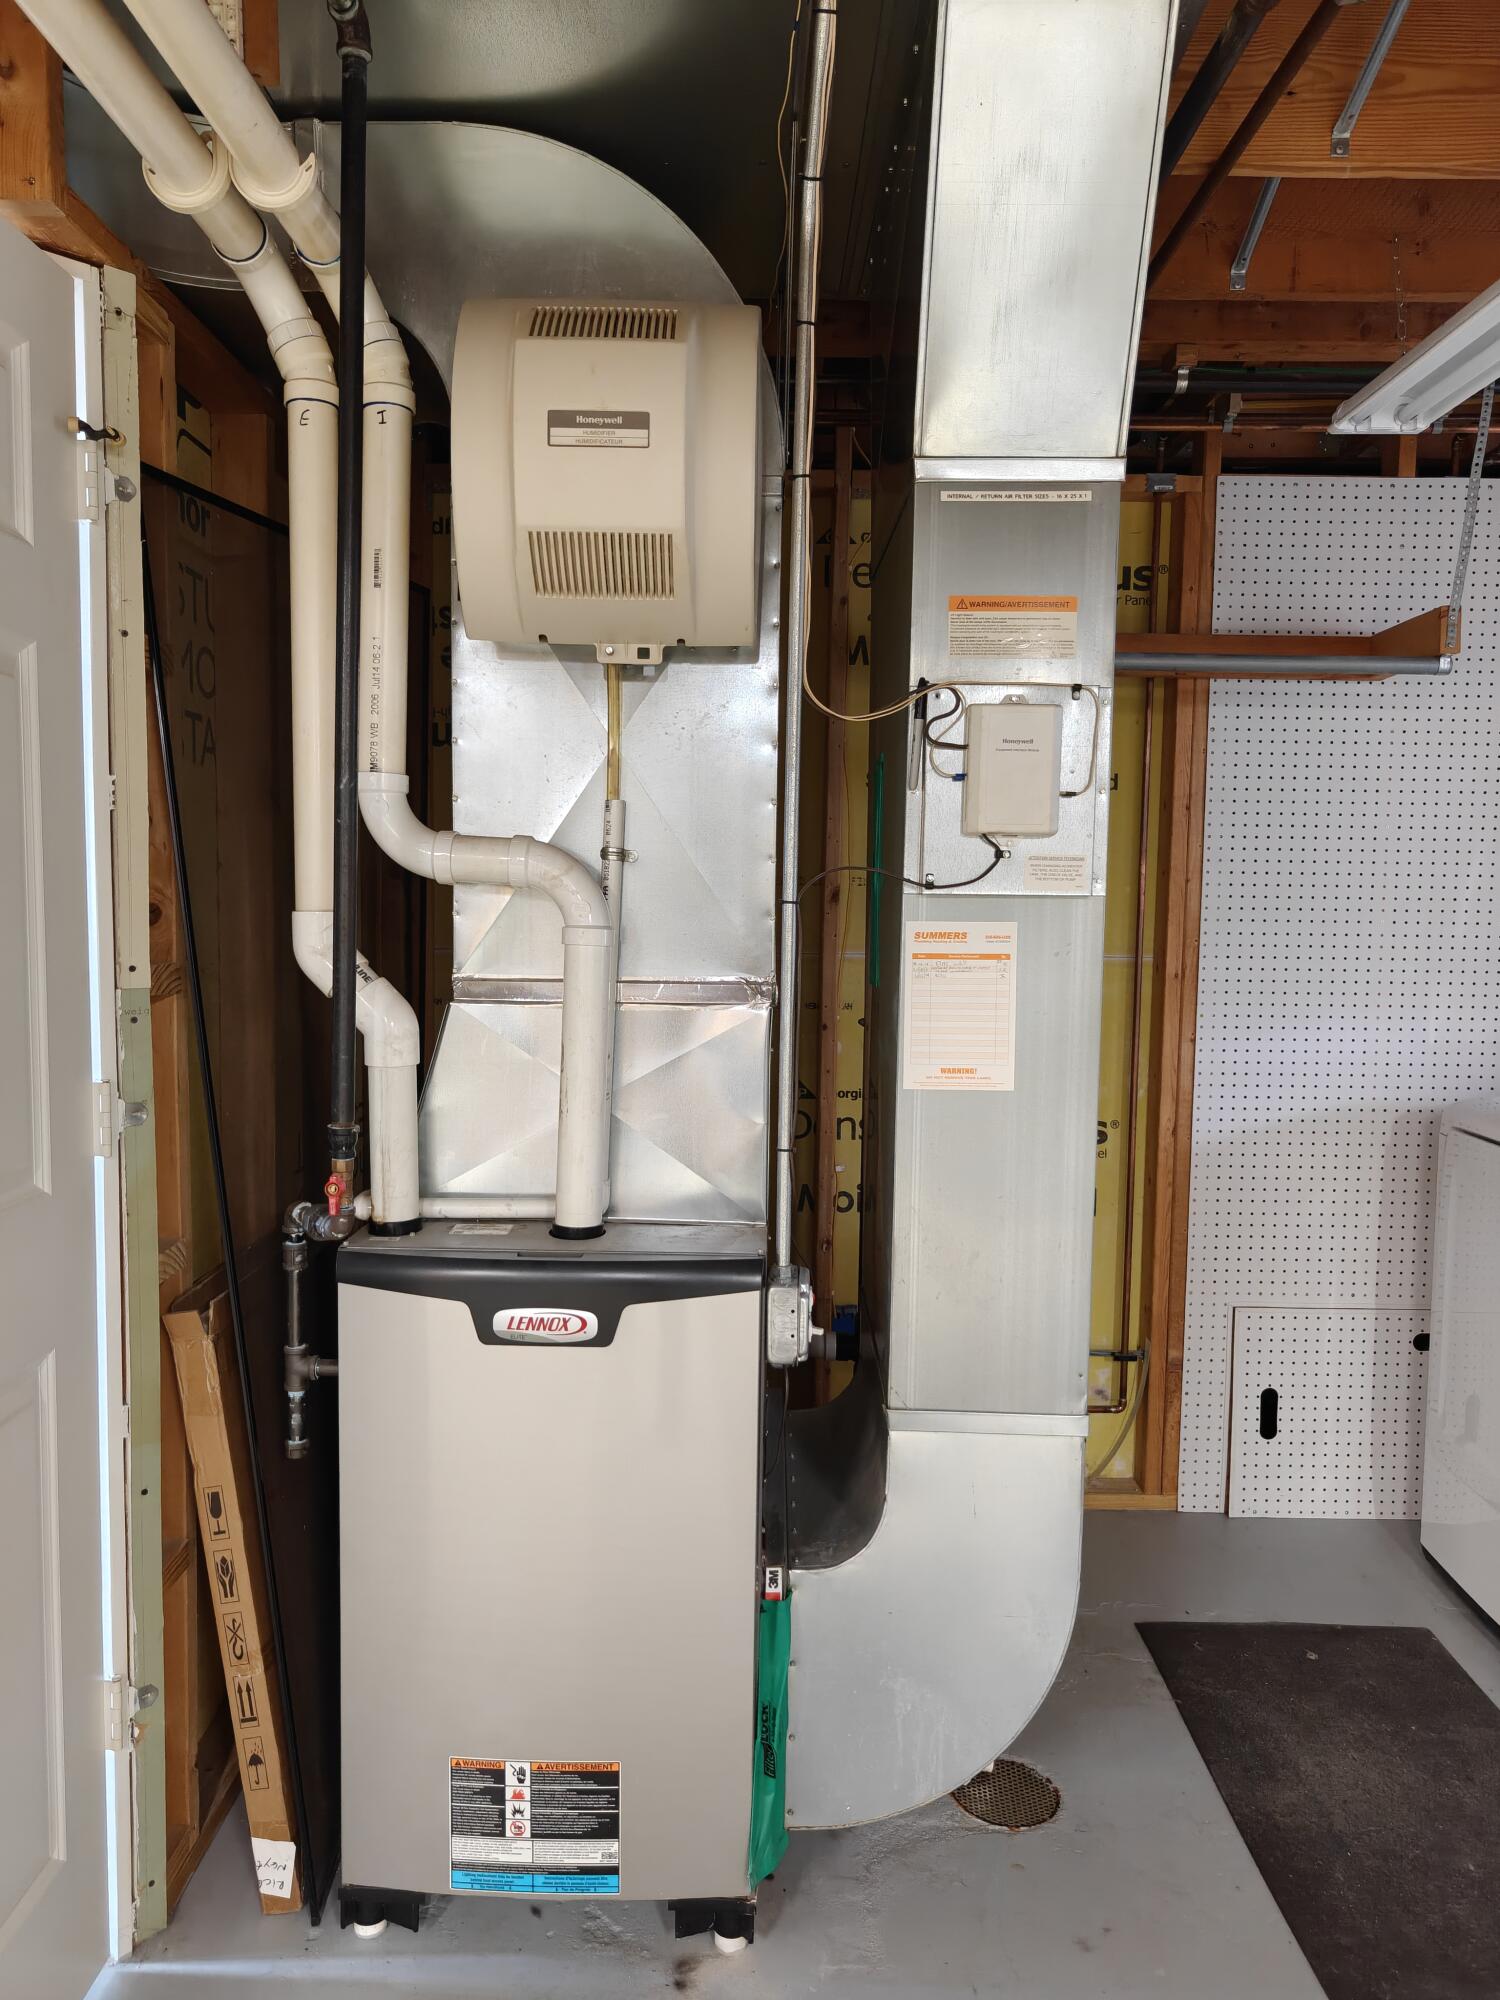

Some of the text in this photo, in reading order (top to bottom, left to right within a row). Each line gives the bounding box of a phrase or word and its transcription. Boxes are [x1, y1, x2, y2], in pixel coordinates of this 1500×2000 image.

[300, 409, 310, 426] E
[377, 410, 387, 424] I
[576, 415, 623, 425] Honeywell
[969, 601, 1071, 609] WARNING/AVERTISSEMENT
[914, 931, 968, 940] SUMMERS
[940, 1067, 977, 1075] WARNING!
[506, 1315, 572, 1332] LENNOX
[767, 1569, 780, 1589] 3M
[462, 1760, 502, 1769] WARNING
[544, 1763, 614, 1771] AVERTISSEMENT
